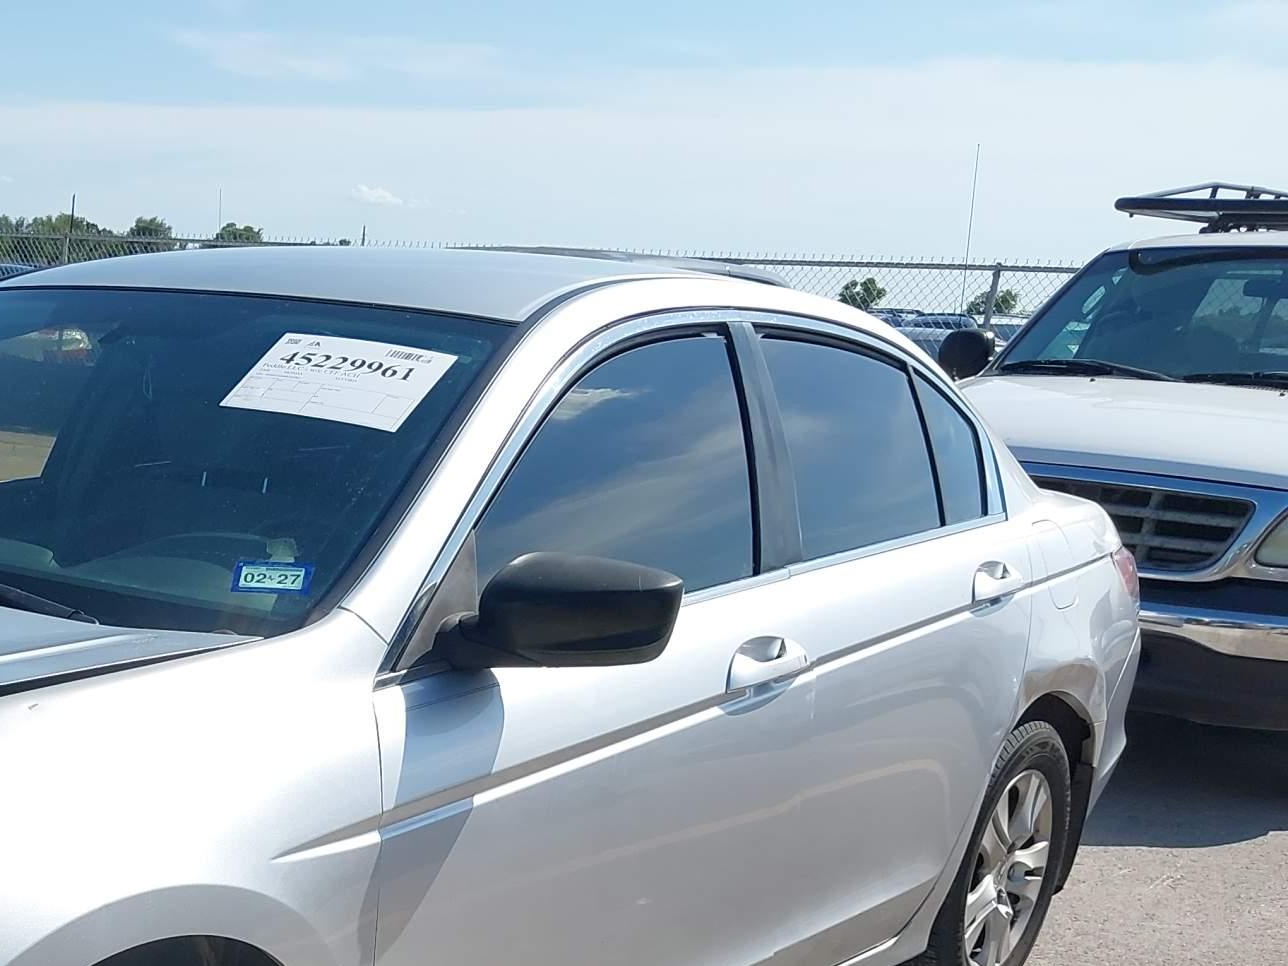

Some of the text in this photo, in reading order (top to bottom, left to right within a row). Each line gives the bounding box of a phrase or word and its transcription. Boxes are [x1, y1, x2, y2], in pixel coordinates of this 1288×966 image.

[280, 351, 415, 381] 45229961
[243, 572, 301, 585] 02 27
